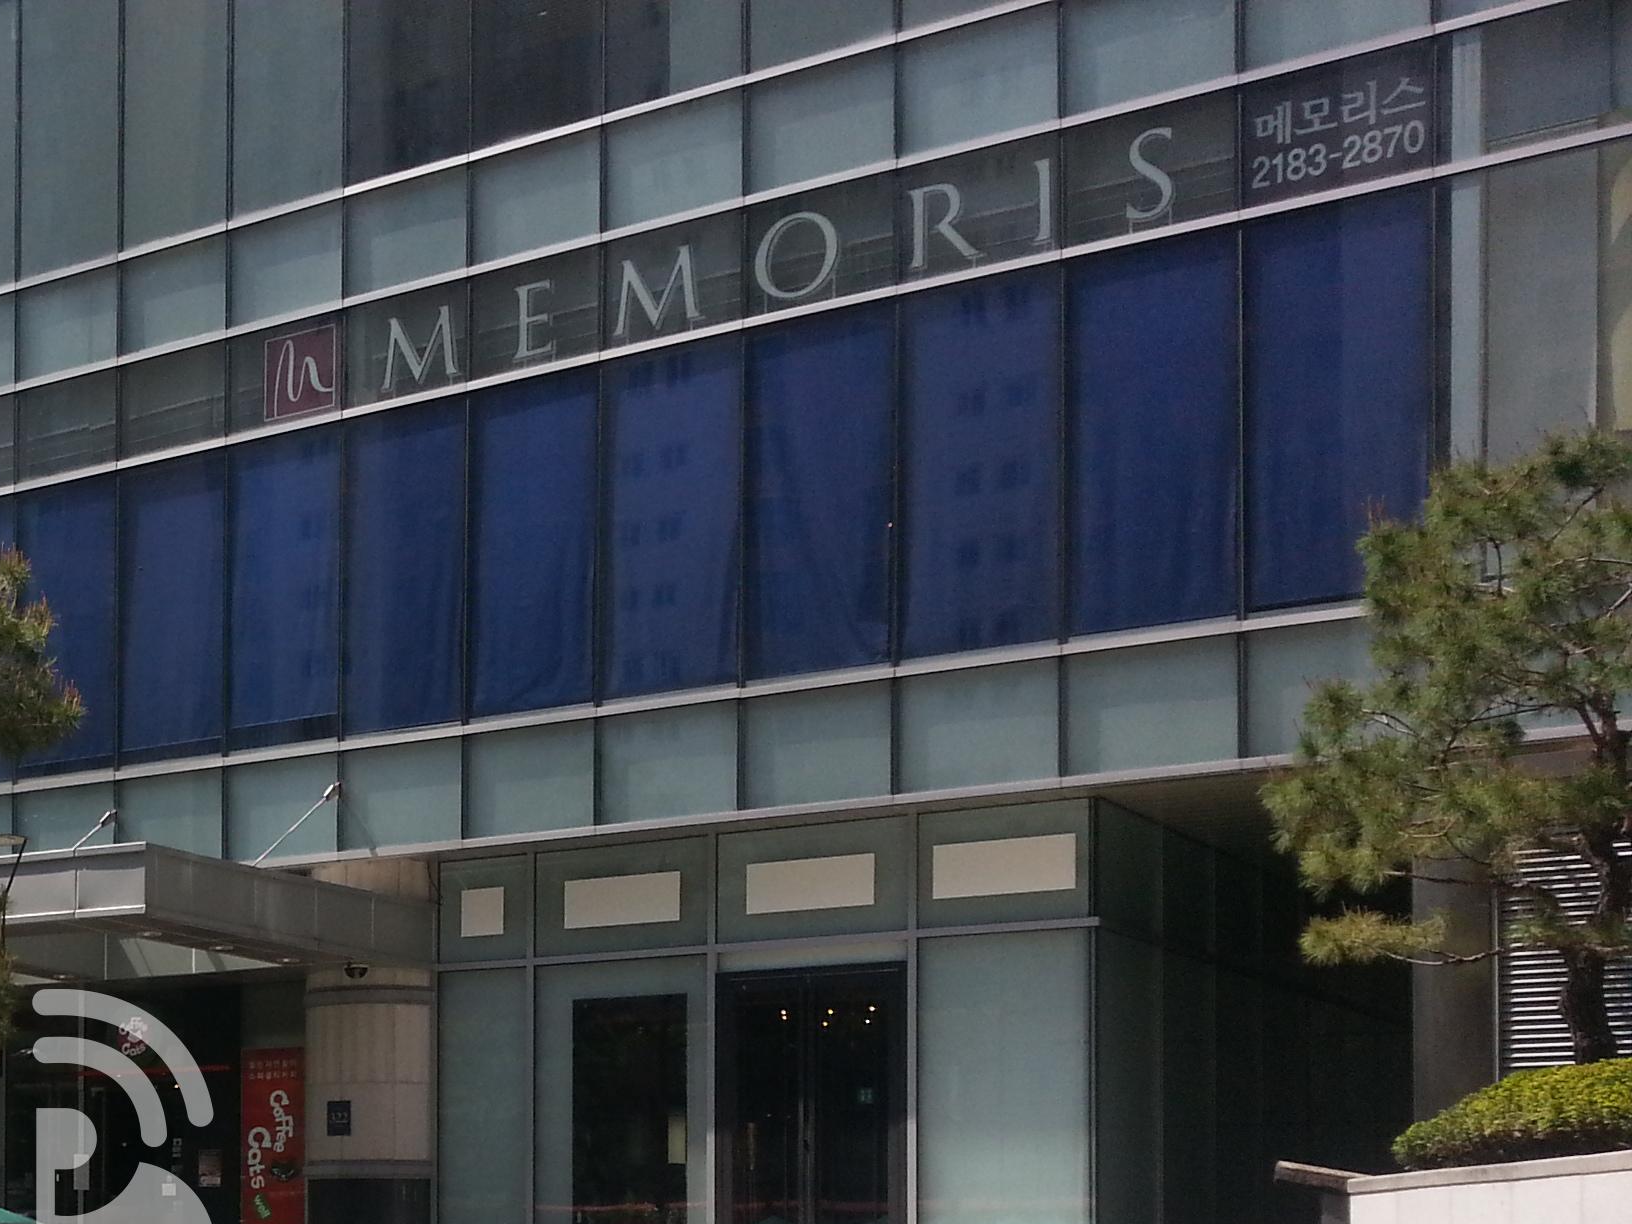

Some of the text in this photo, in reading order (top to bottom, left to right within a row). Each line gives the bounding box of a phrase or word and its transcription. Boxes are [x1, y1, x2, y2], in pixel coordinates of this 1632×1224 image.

[1254, 77, 1426, 145] 메모리스
[1252, 119, 1425, 189] 2183-2870
[382, 126, 1175, 392] MEMORIS
